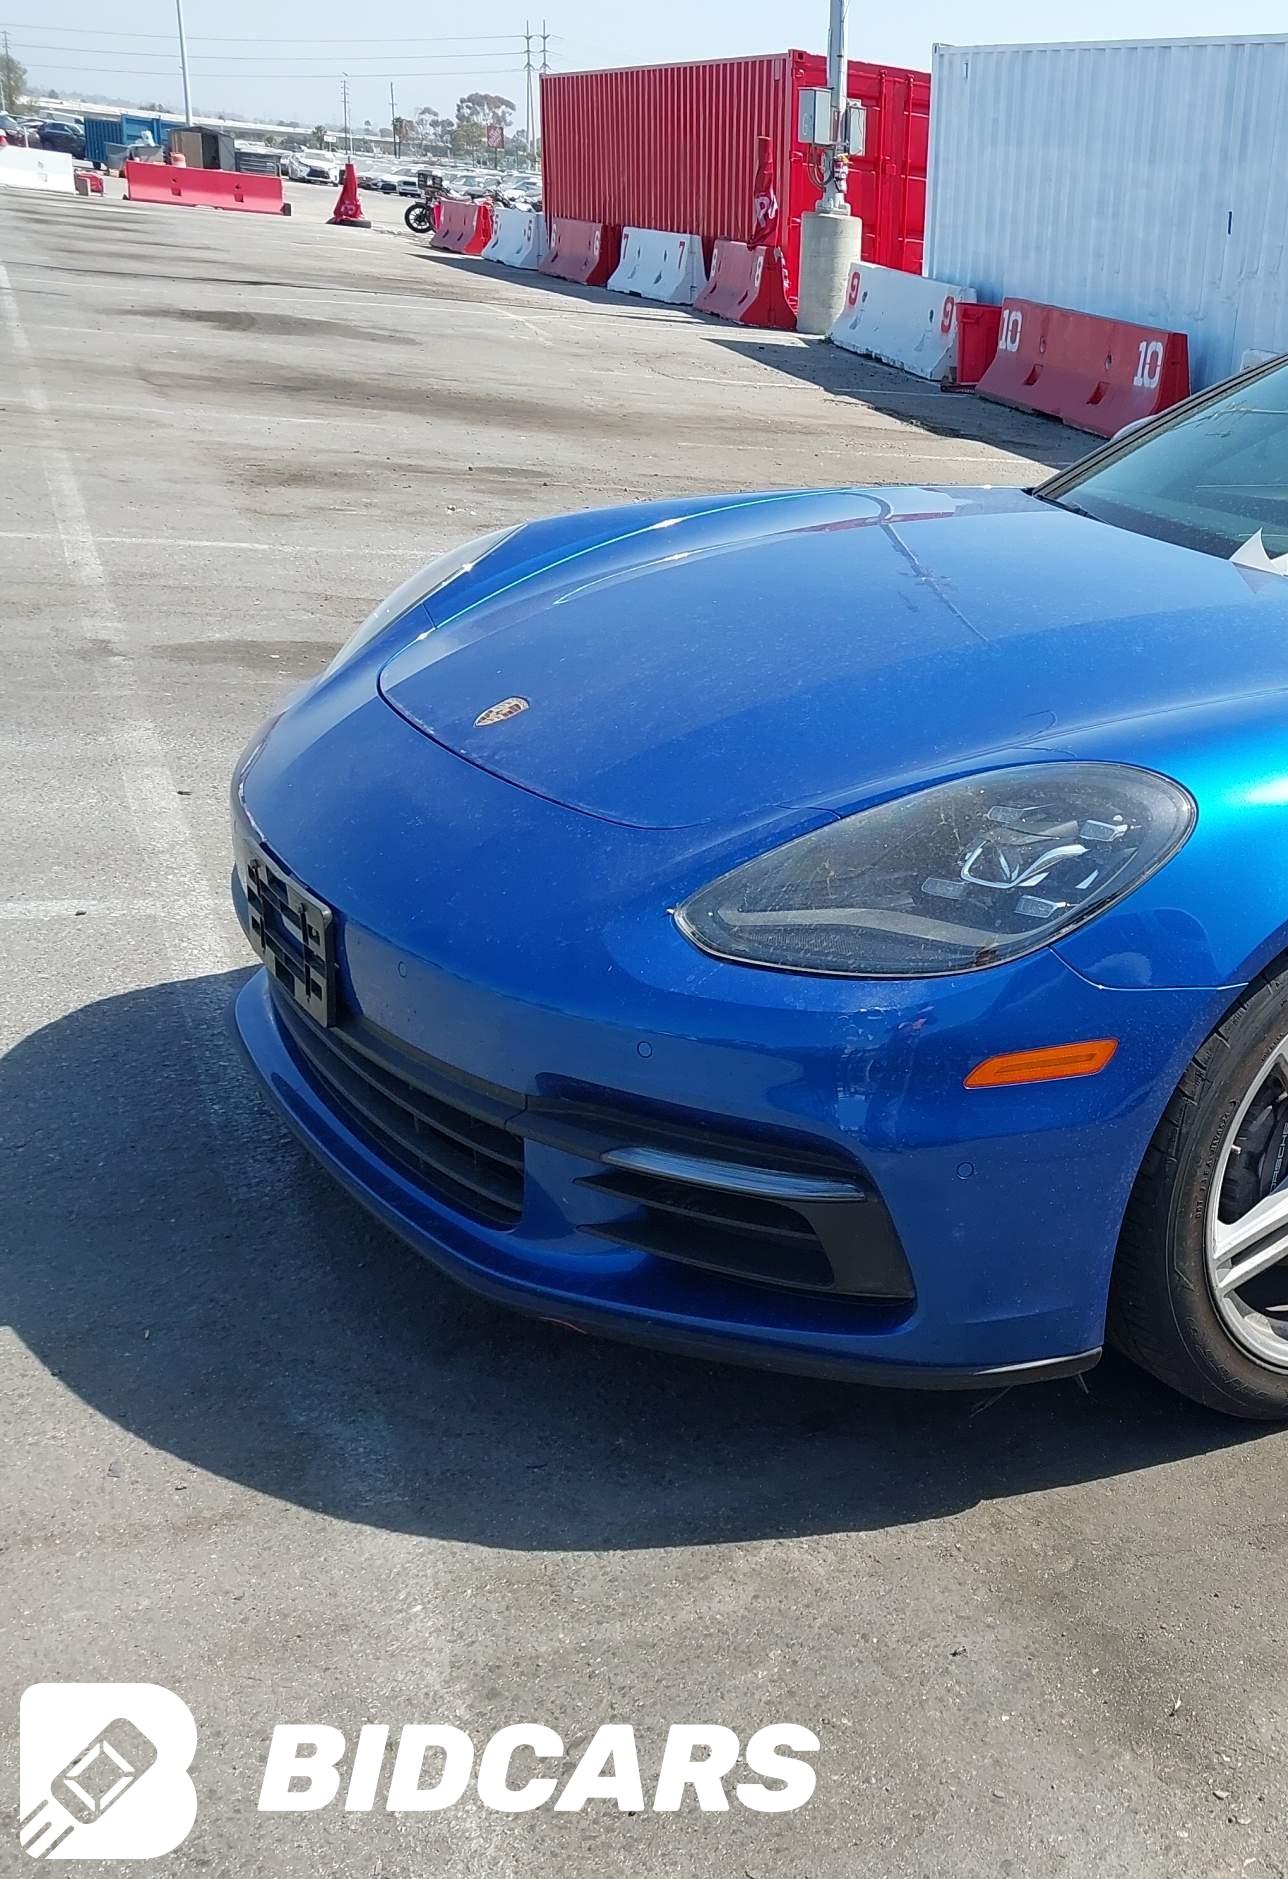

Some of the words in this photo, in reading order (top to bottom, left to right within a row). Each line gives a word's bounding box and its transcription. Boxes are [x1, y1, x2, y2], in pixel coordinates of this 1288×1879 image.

[594, 231, 600, 256] 6
[623, 233, 629, 259] 7
[679, 241, 685, 268] 7
[754, 256, 763, 287] 8
[848, 271, 861, 306] 9
[941, 296, 954, 334] 9
[999, 309, 1023, 352] 10
[1133, 341, 1163, 388] 10
